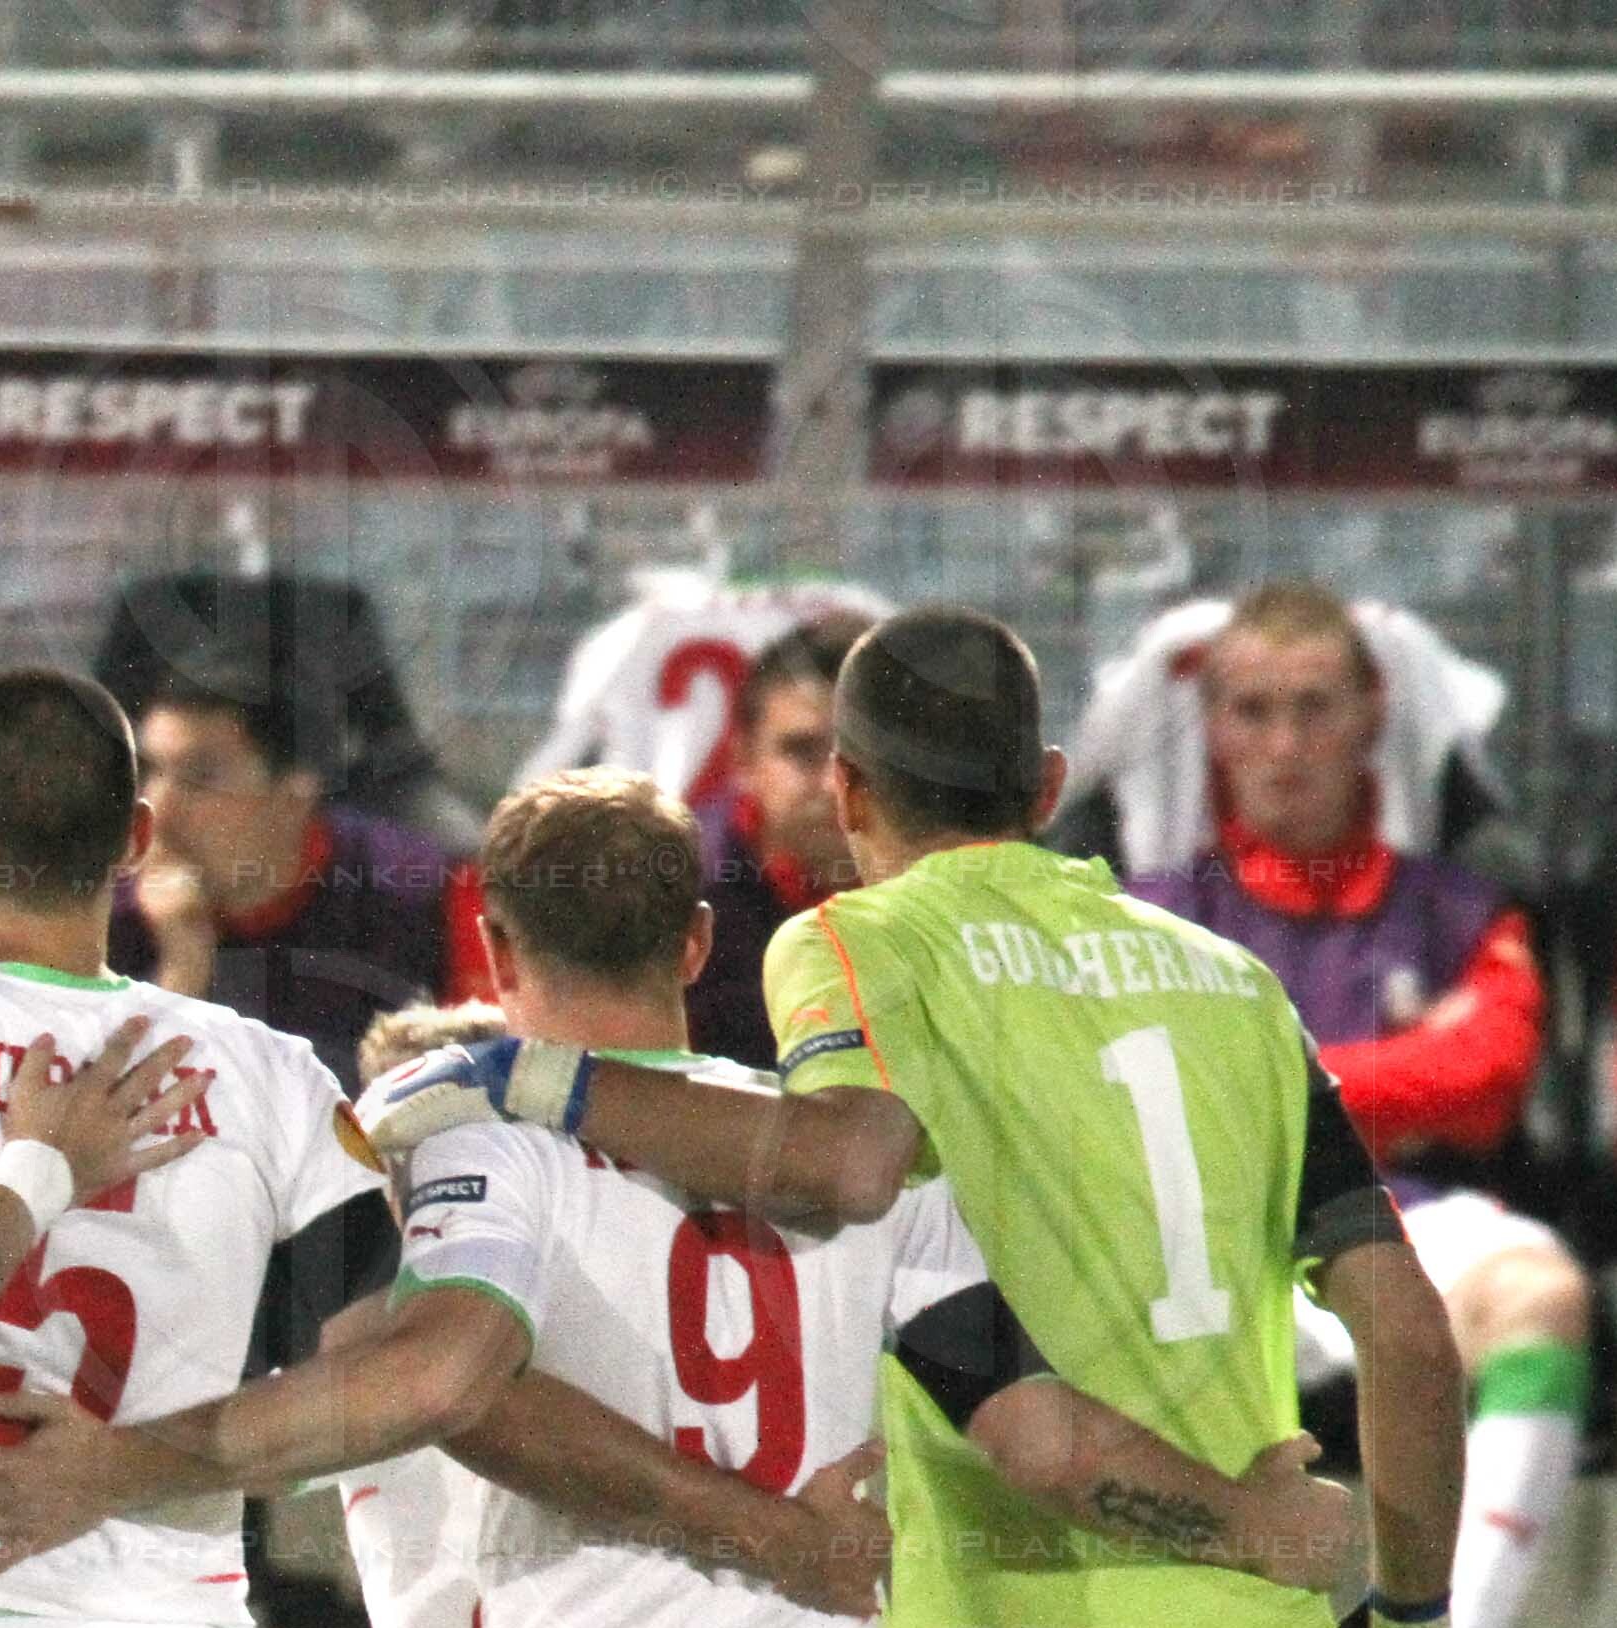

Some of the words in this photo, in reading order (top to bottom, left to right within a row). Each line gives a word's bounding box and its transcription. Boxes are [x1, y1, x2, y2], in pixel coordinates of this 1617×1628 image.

[960, 390, 1281, 454] RESPECT
[1098, 1024, 1233, 1343] 1
[668, 1210, 807, 1498] 9
